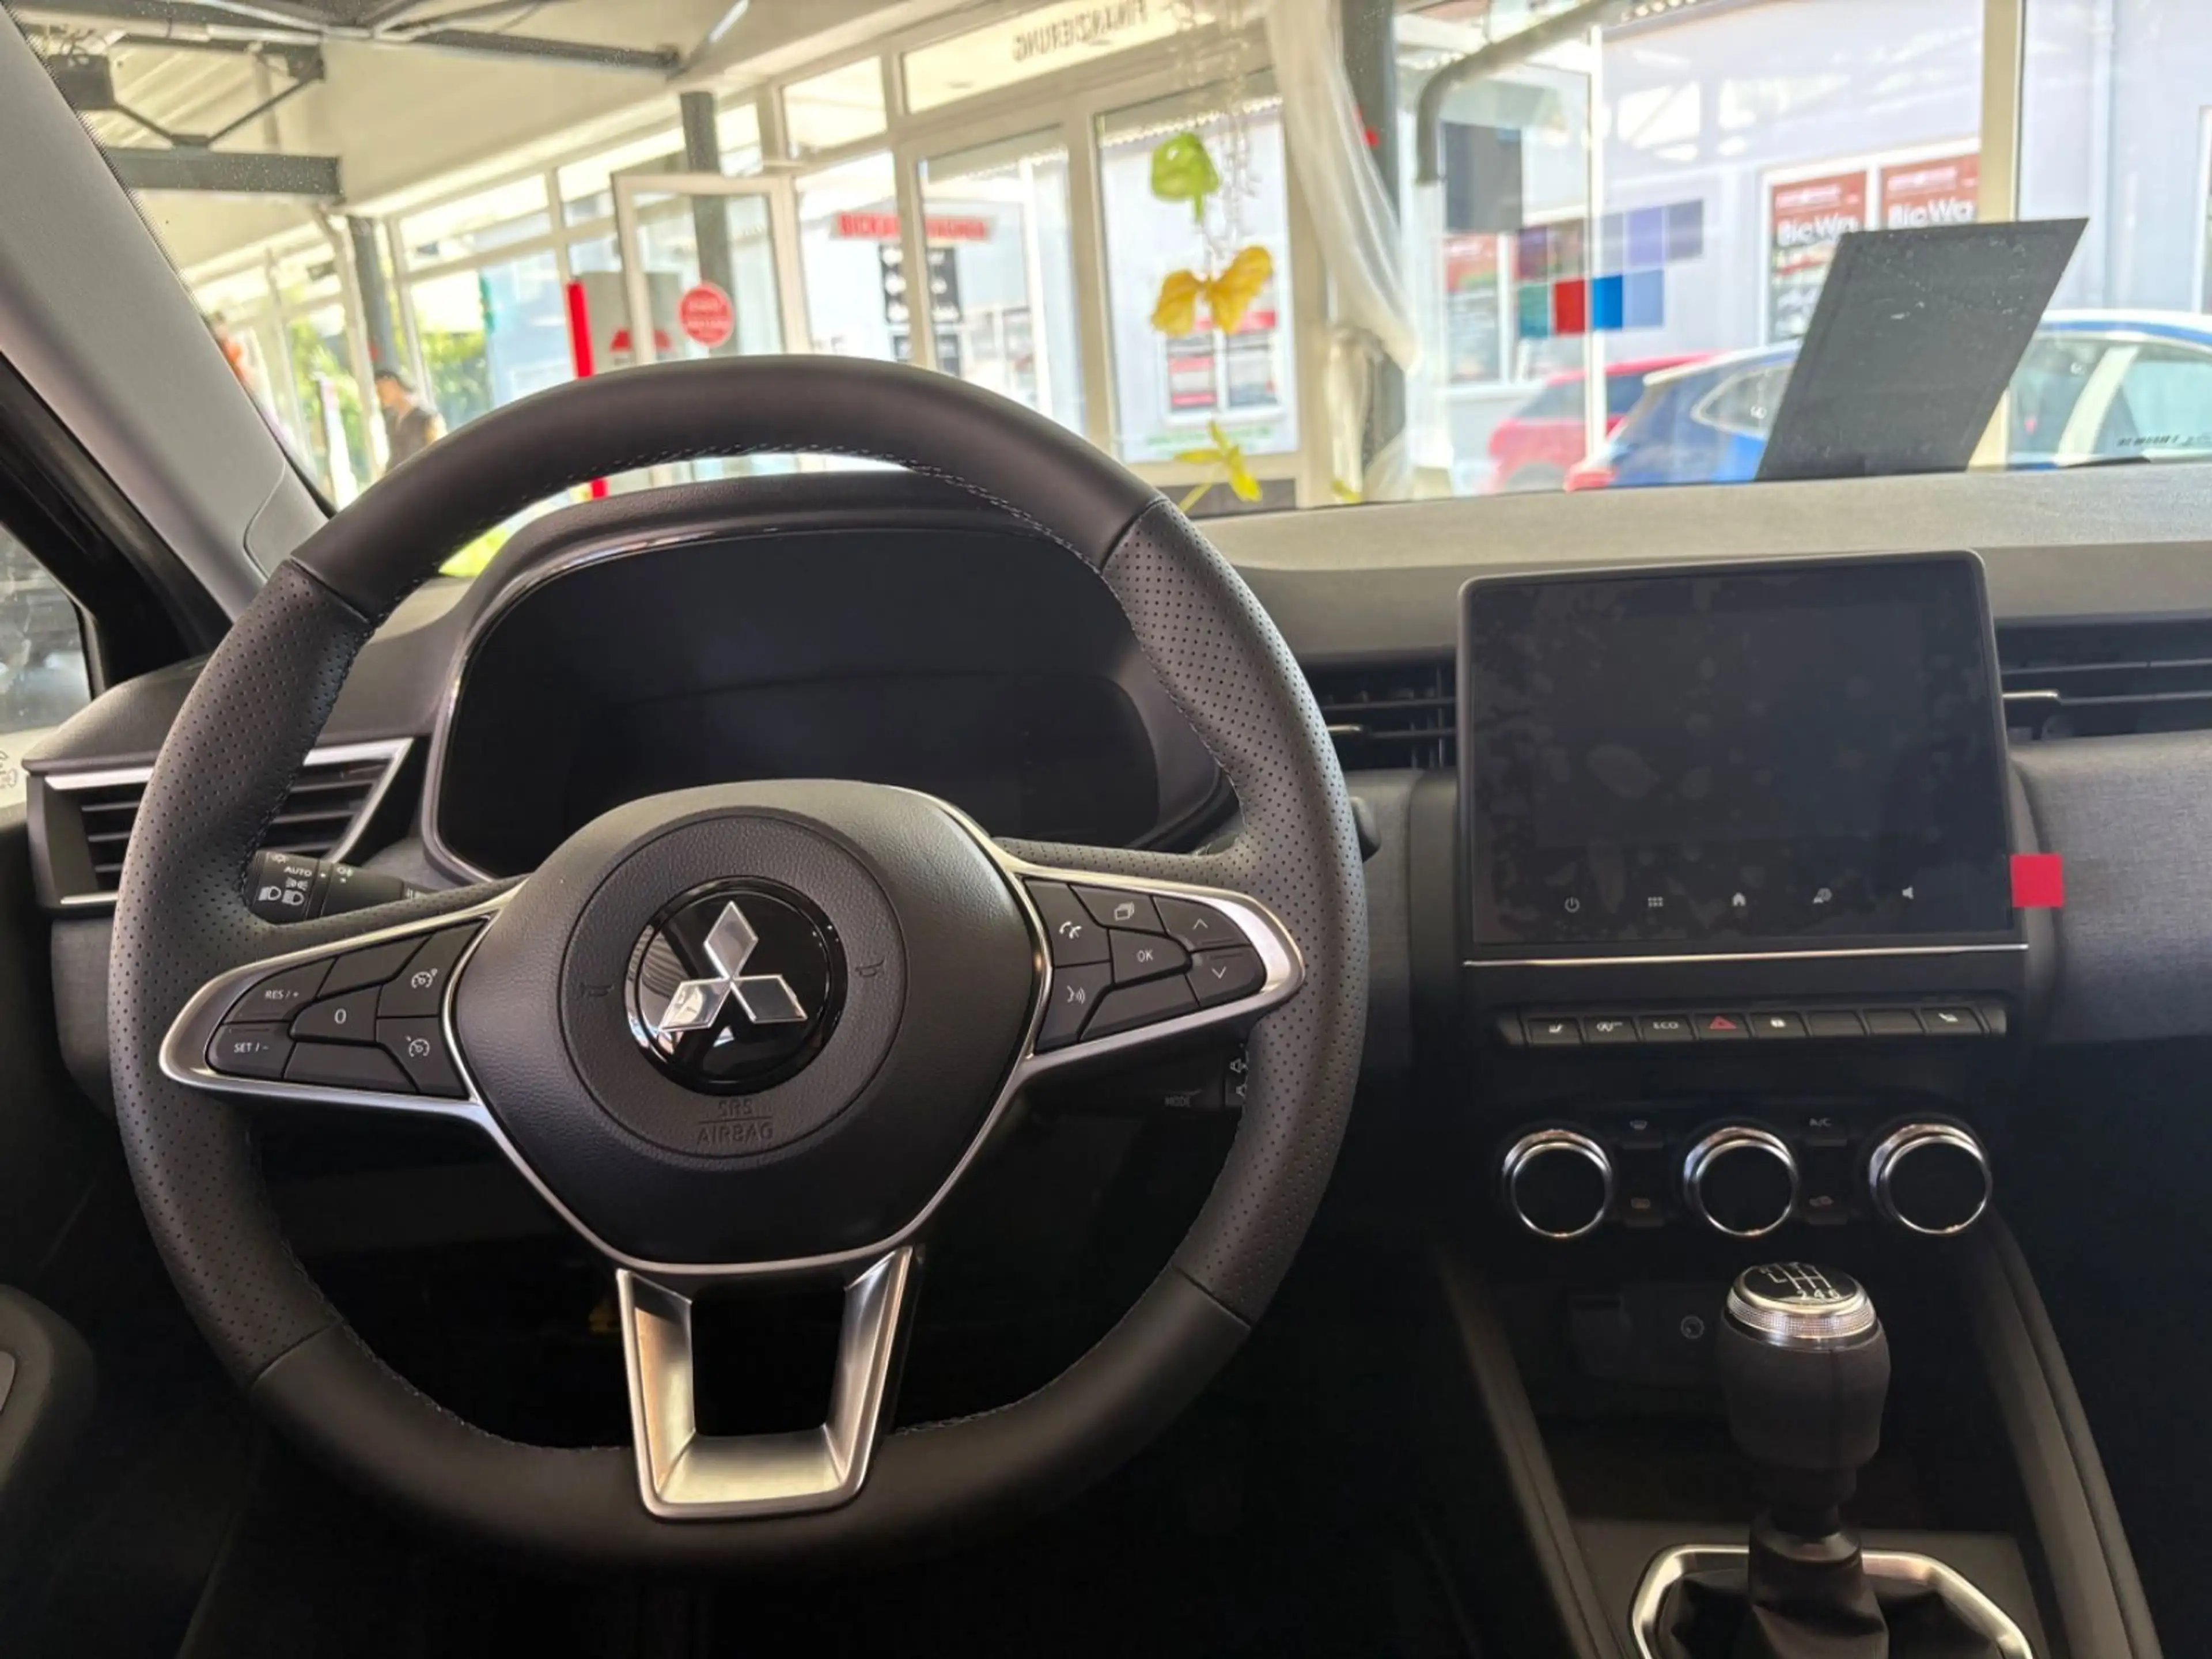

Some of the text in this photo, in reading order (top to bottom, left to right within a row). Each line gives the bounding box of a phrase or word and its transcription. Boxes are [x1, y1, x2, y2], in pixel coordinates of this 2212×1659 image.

[284, 866, 313, 877] AUTO
[1137, 949, 1154, 963] OK
[265, 989, 284, 1000] RES
[1652, 1021, 1680, 1030] ECO
[234, 1041, 253, 1054] SET
[718, 1099, 752, 1116] SRS
[1809, 1117, 1832, 1128] A/C
[696, 1122, 774, 1146] AIRBAG
